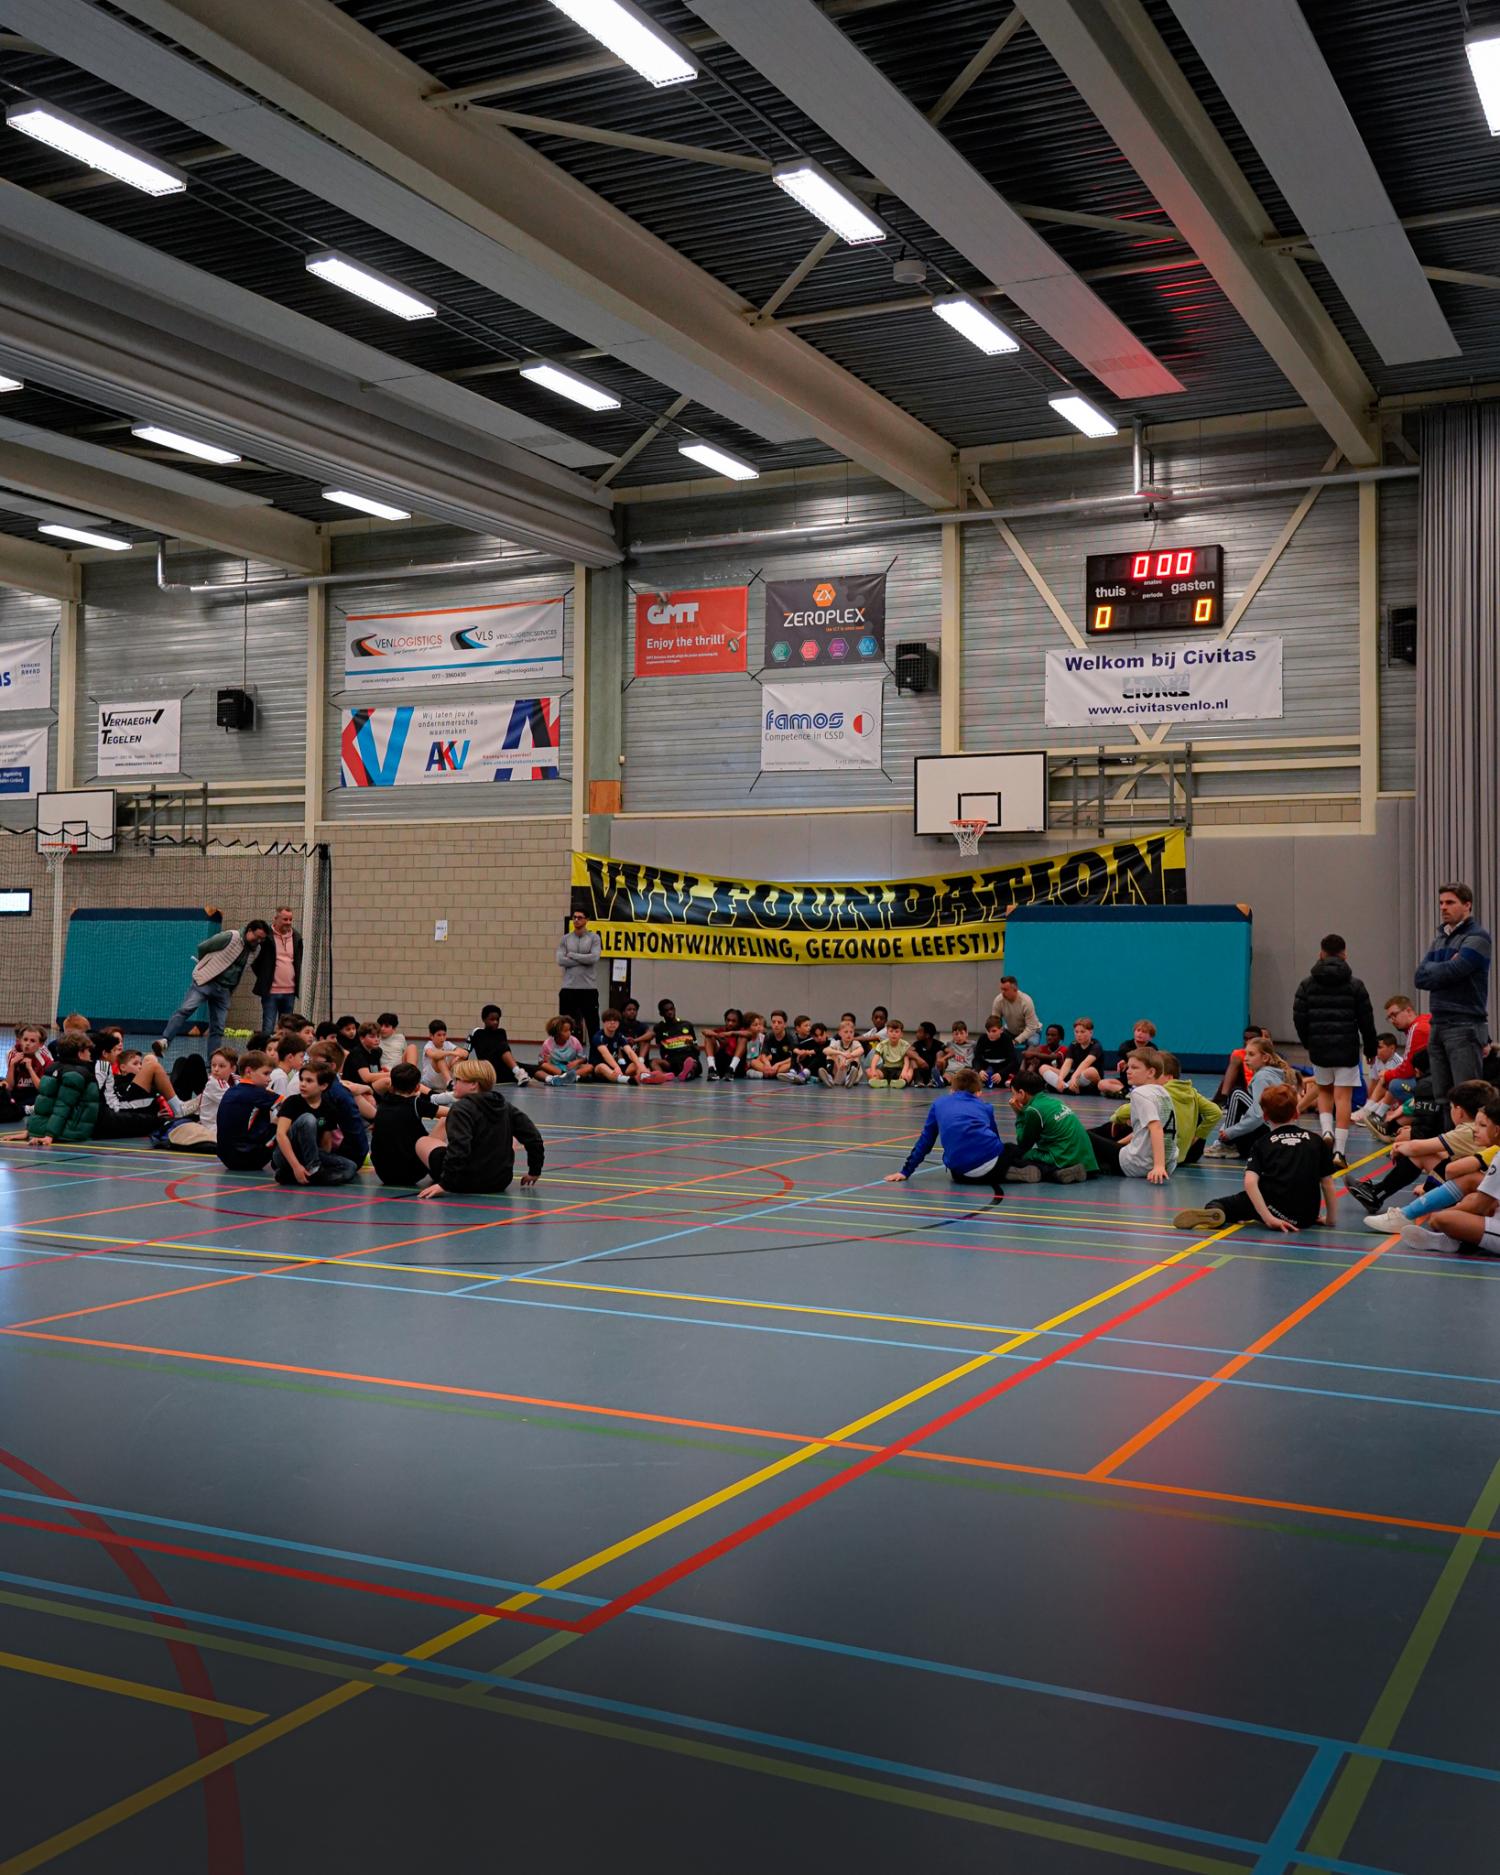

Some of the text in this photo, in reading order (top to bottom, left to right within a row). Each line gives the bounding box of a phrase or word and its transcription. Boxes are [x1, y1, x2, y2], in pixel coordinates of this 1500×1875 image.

[1095, 585, 1127, 598] thuis
[1170, 579, 1216, 595] gasten
[646, 602, 699, 625] GMT
[783, 607, 866, 628] ZEROPLEX
[1094, 606, 1112, 629] 0
[1194, 598, 1212, 622] 0
[375, 634, 443, 649] VENLOGISTICS
[475, 630, 494, 641] VLS
[646, 634, 725, 650] Enjoy the thrill!
[1064, 647, 1257, 672] Welkom bij Civitas
[435, 711, 453, 719] laten
[1087, 699, 1229, 715] www.civitasvenlo.nl
[101, 711, 152, 727] VERHAEGH
[765, 709, 844, 730] famos
[101, 729, 142, 745] TEGELEN
[764, 730, 844, 743] Competence in CSSD
[424, 739, 471, 772] AKV
[596, 929, 801, 962] ALENTONTWIKKELING,
[806, 936, 903, 960] GEZONDE
[1269, 1131, 1312, 1144] SCELTA
